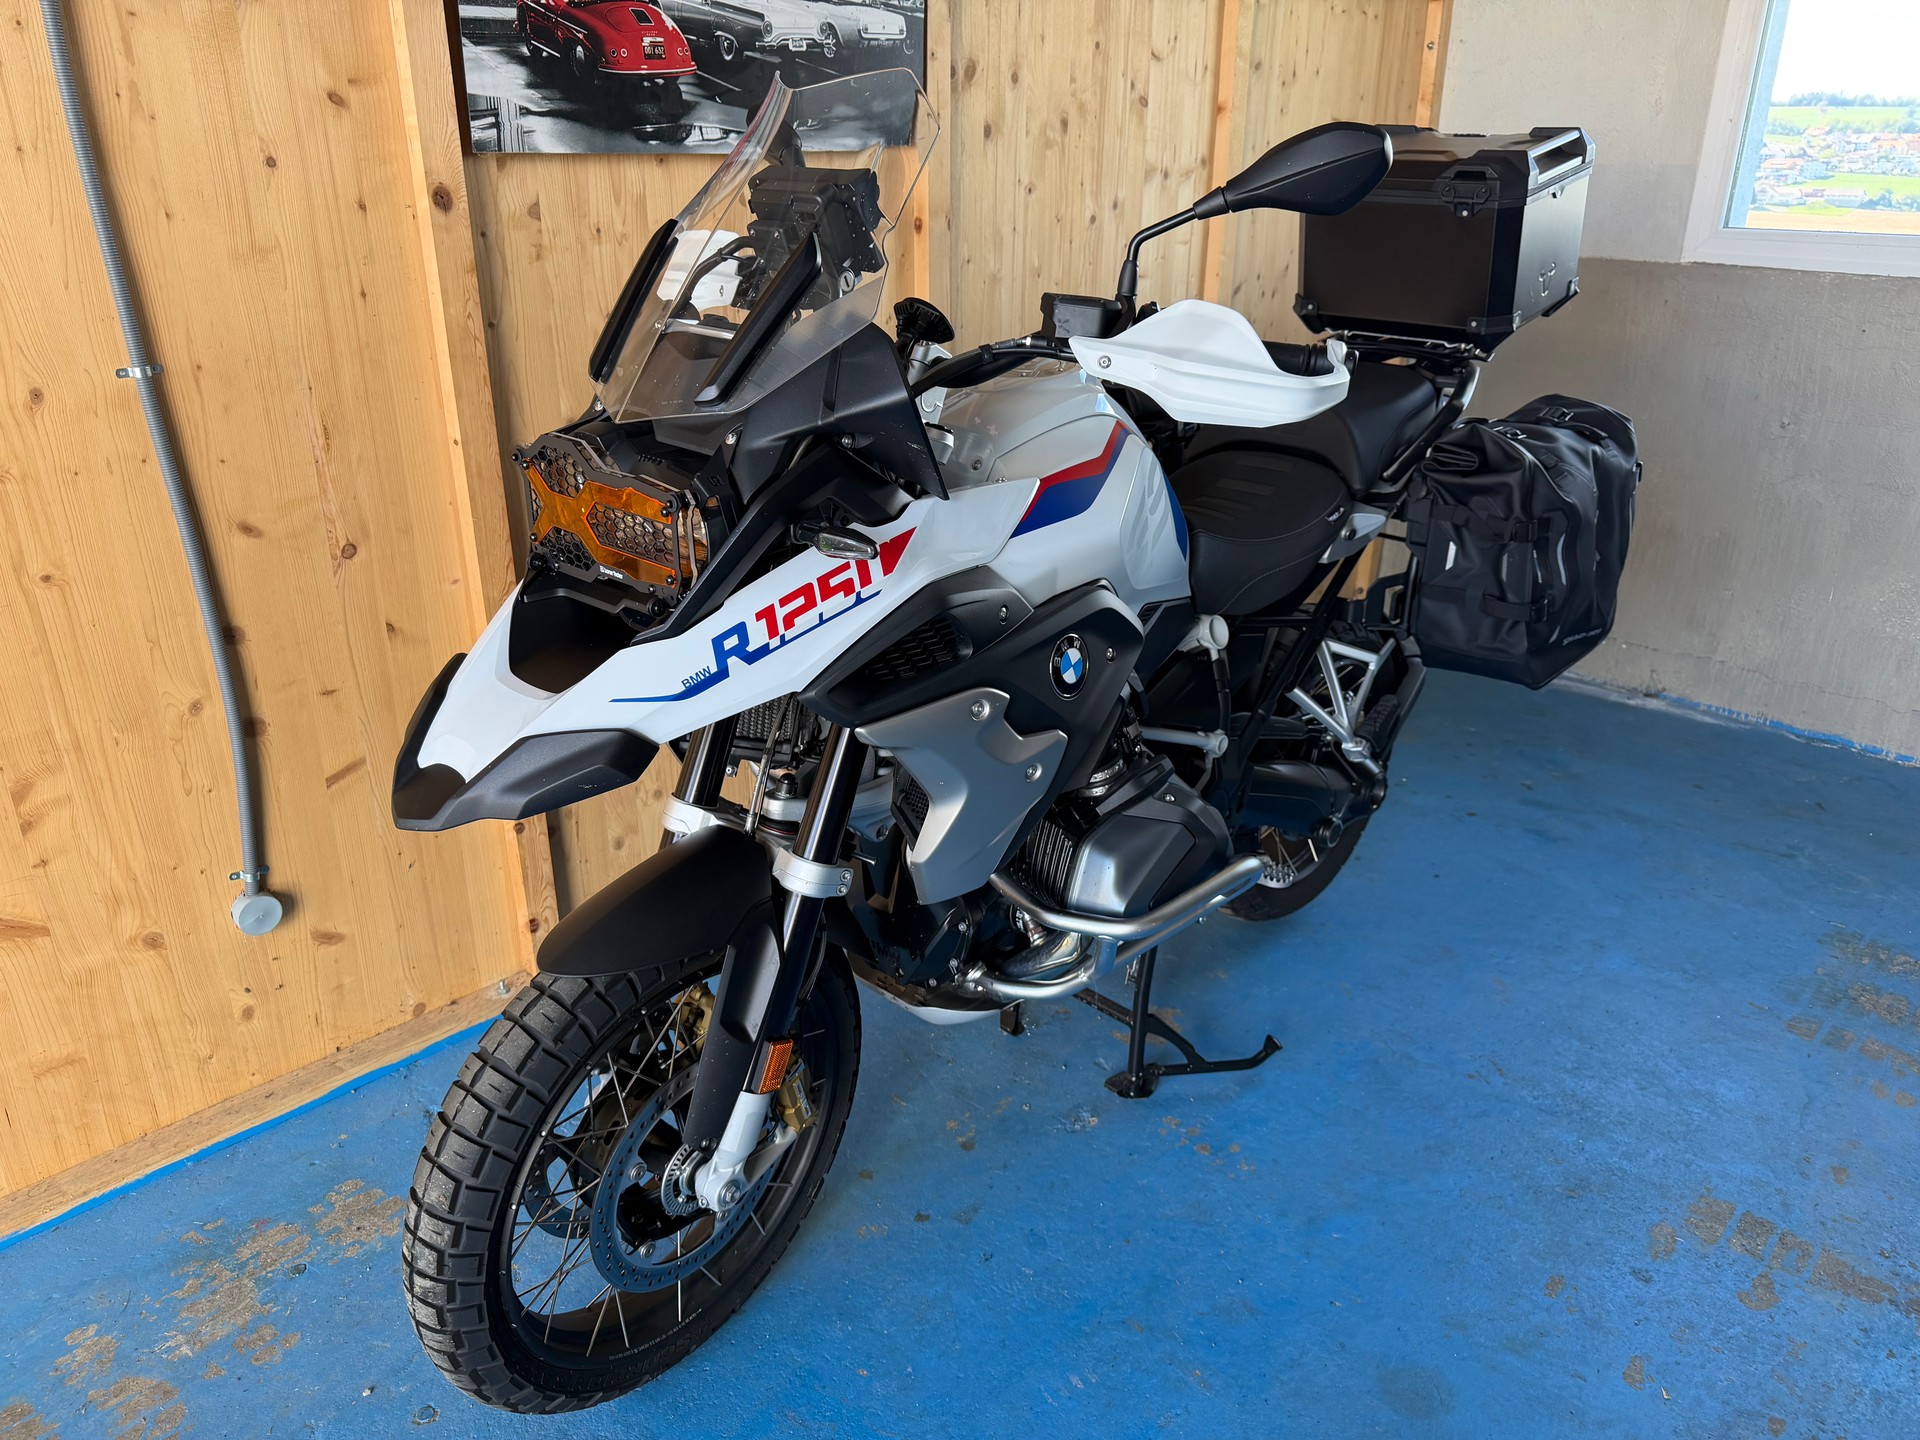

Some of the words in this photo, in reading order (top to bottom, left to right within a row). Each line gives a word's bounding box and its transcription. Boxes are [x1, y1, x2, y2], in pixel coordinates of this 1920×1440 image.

[681, 665, 712, 689] BMW
[711, 621, 753, 678] R
[1053, 637, 1081, 668] BMW
